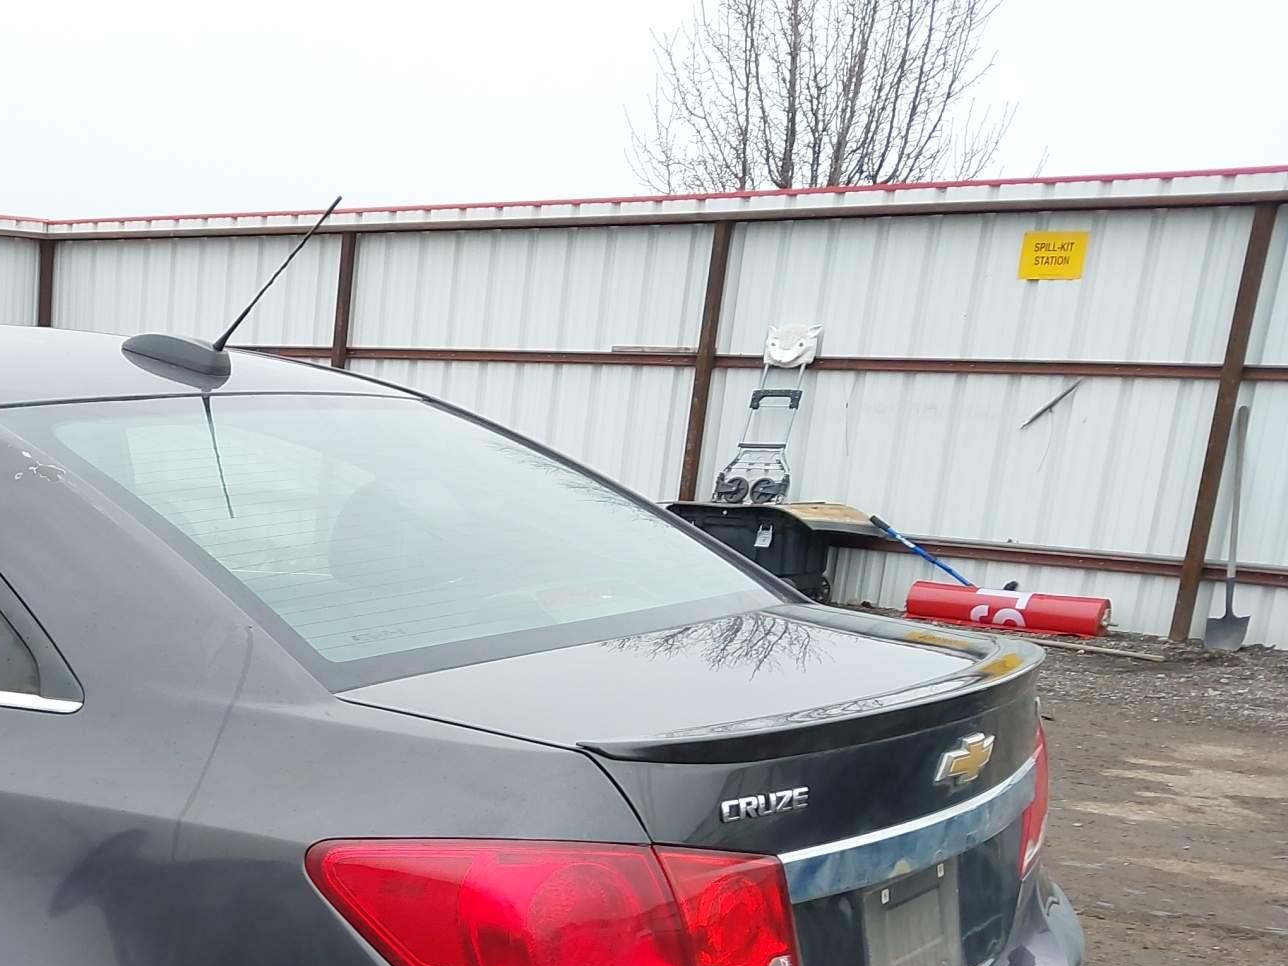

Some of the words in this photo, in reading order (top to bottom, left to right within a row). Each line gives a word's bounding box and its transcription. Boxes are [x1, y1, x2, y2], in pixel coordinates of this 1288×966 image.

[1033, 241, 1075, 252] SPILL-KIT
[1033, 255, 1070, 265] STATION
[720, 786, 810, 823] CRUZE
